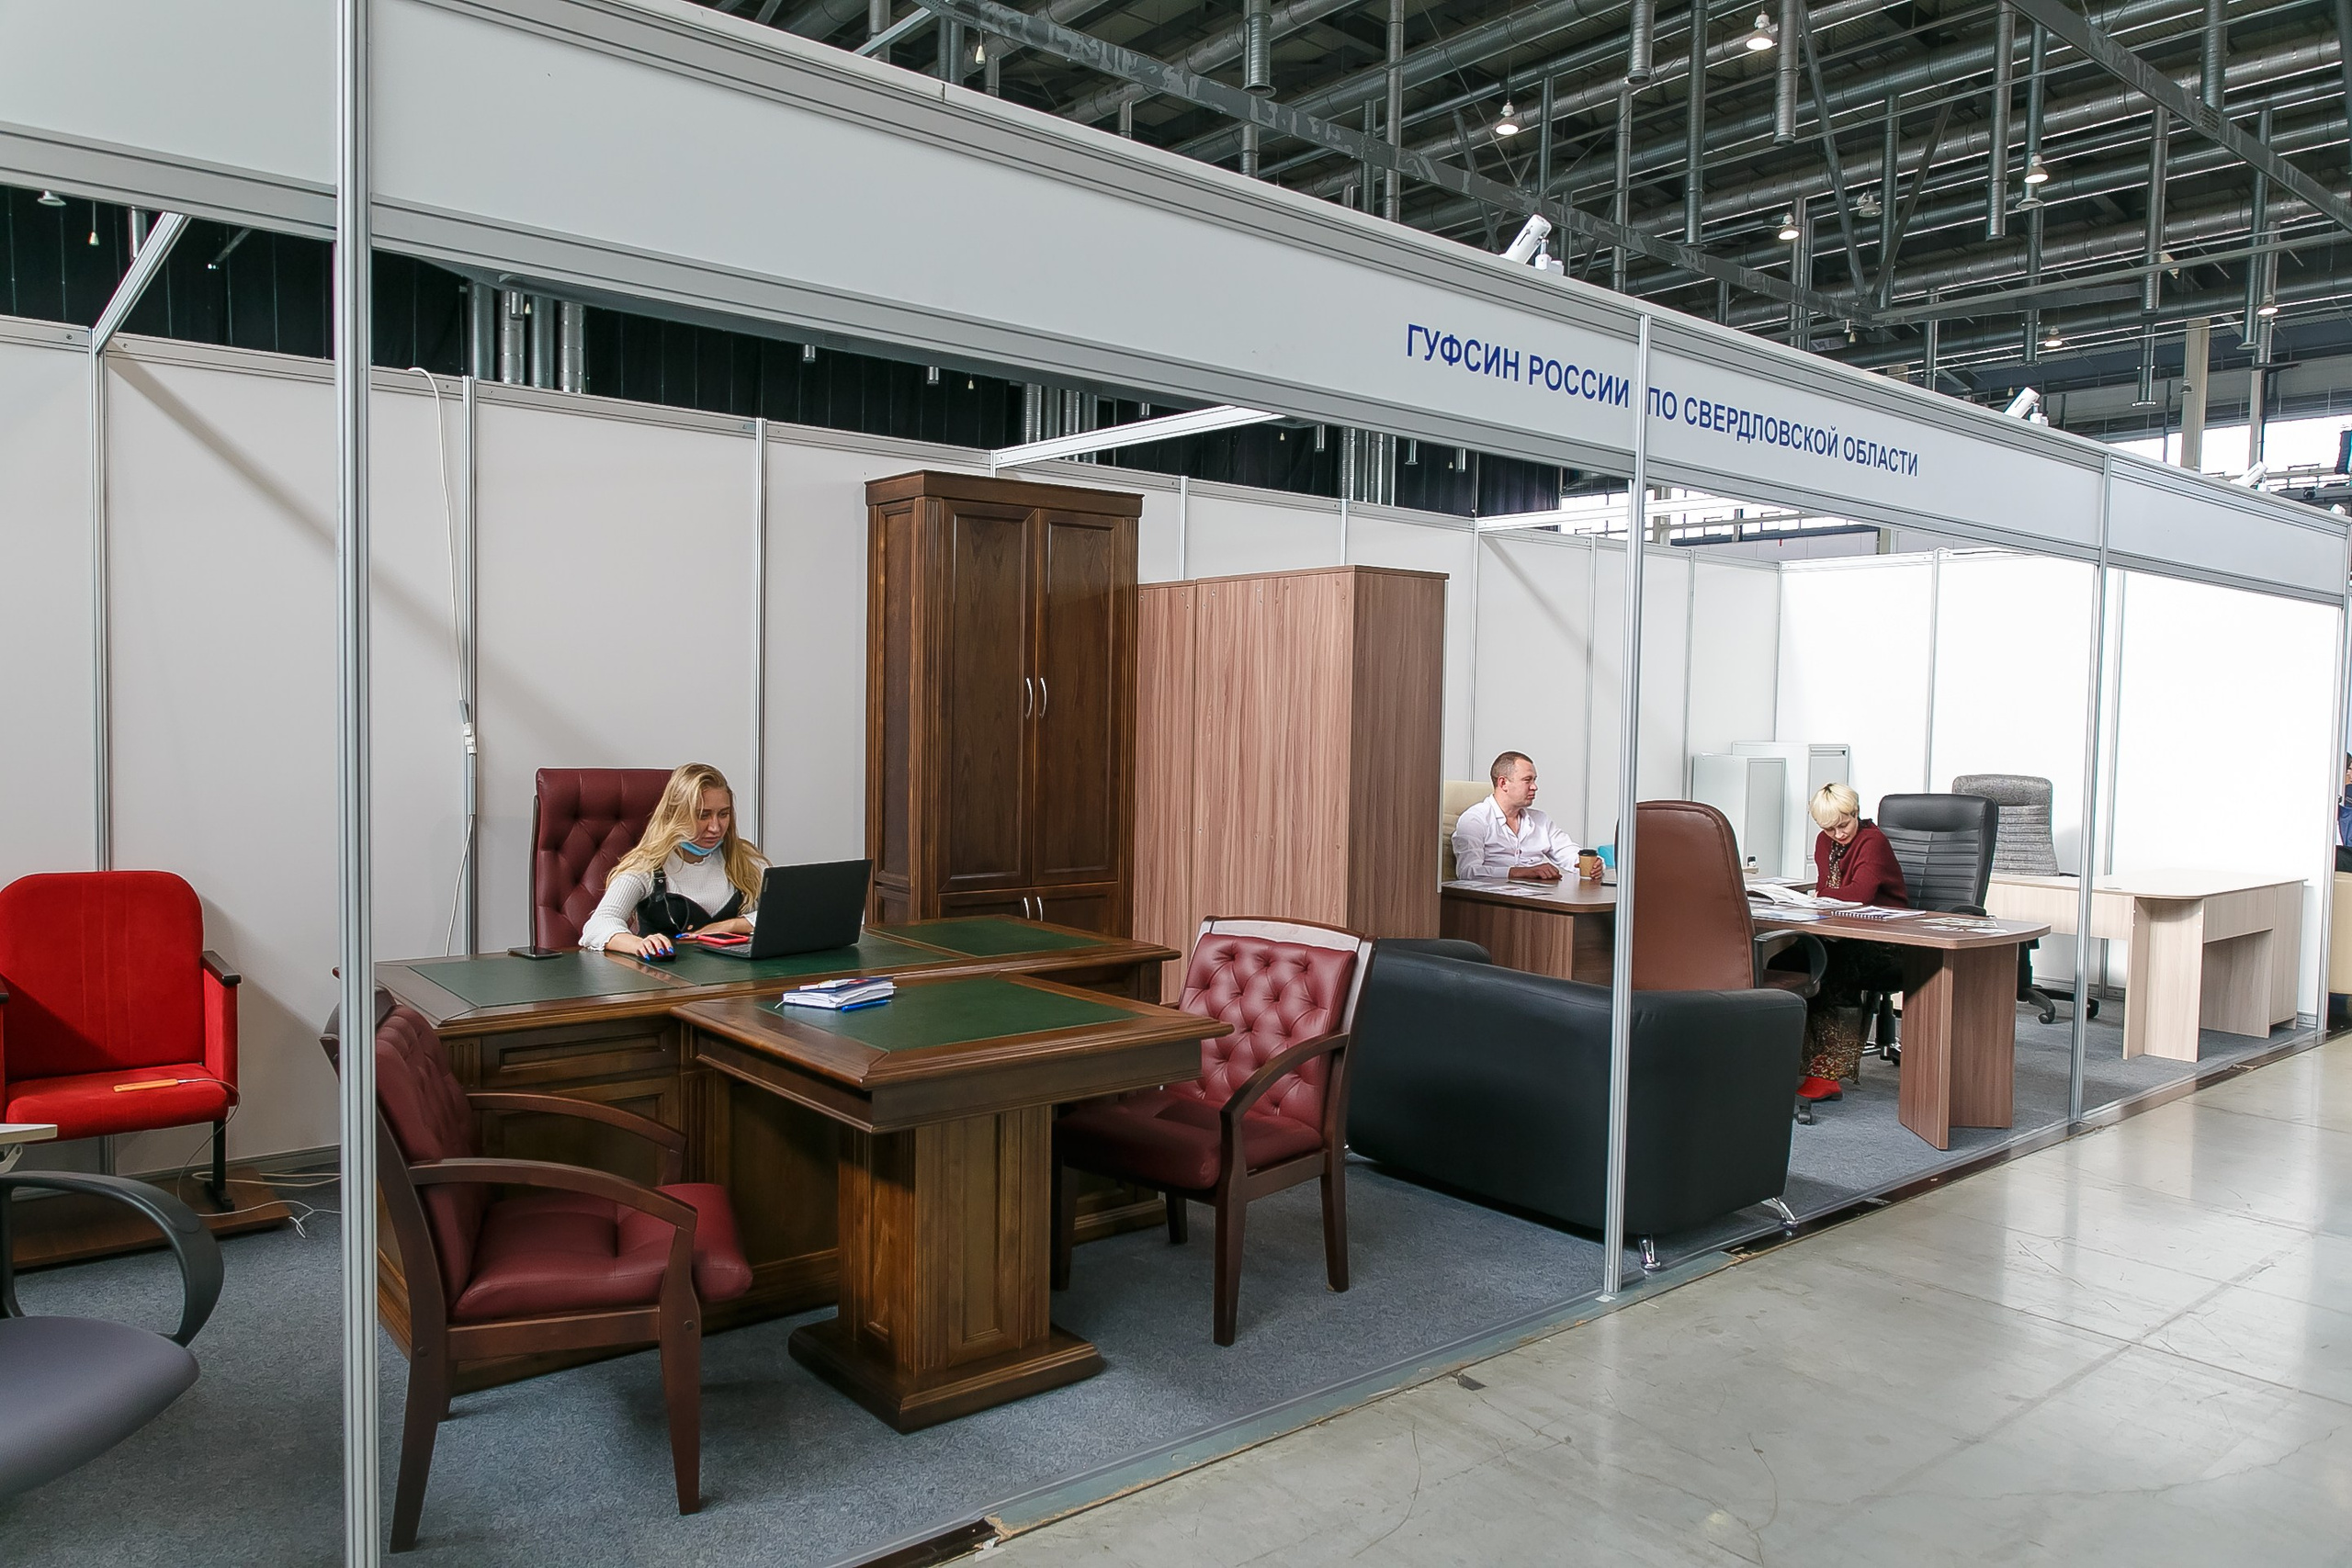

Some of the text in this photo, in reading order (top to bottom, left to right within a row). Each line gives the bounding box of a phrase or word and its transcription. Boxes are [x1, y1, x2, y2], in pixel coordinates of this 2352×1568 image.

[1407, 323, 1919, 477] ГУФСИН РОССИИ ПО СВЕРДЛОВСКОЙ ОБЛАСТИ
